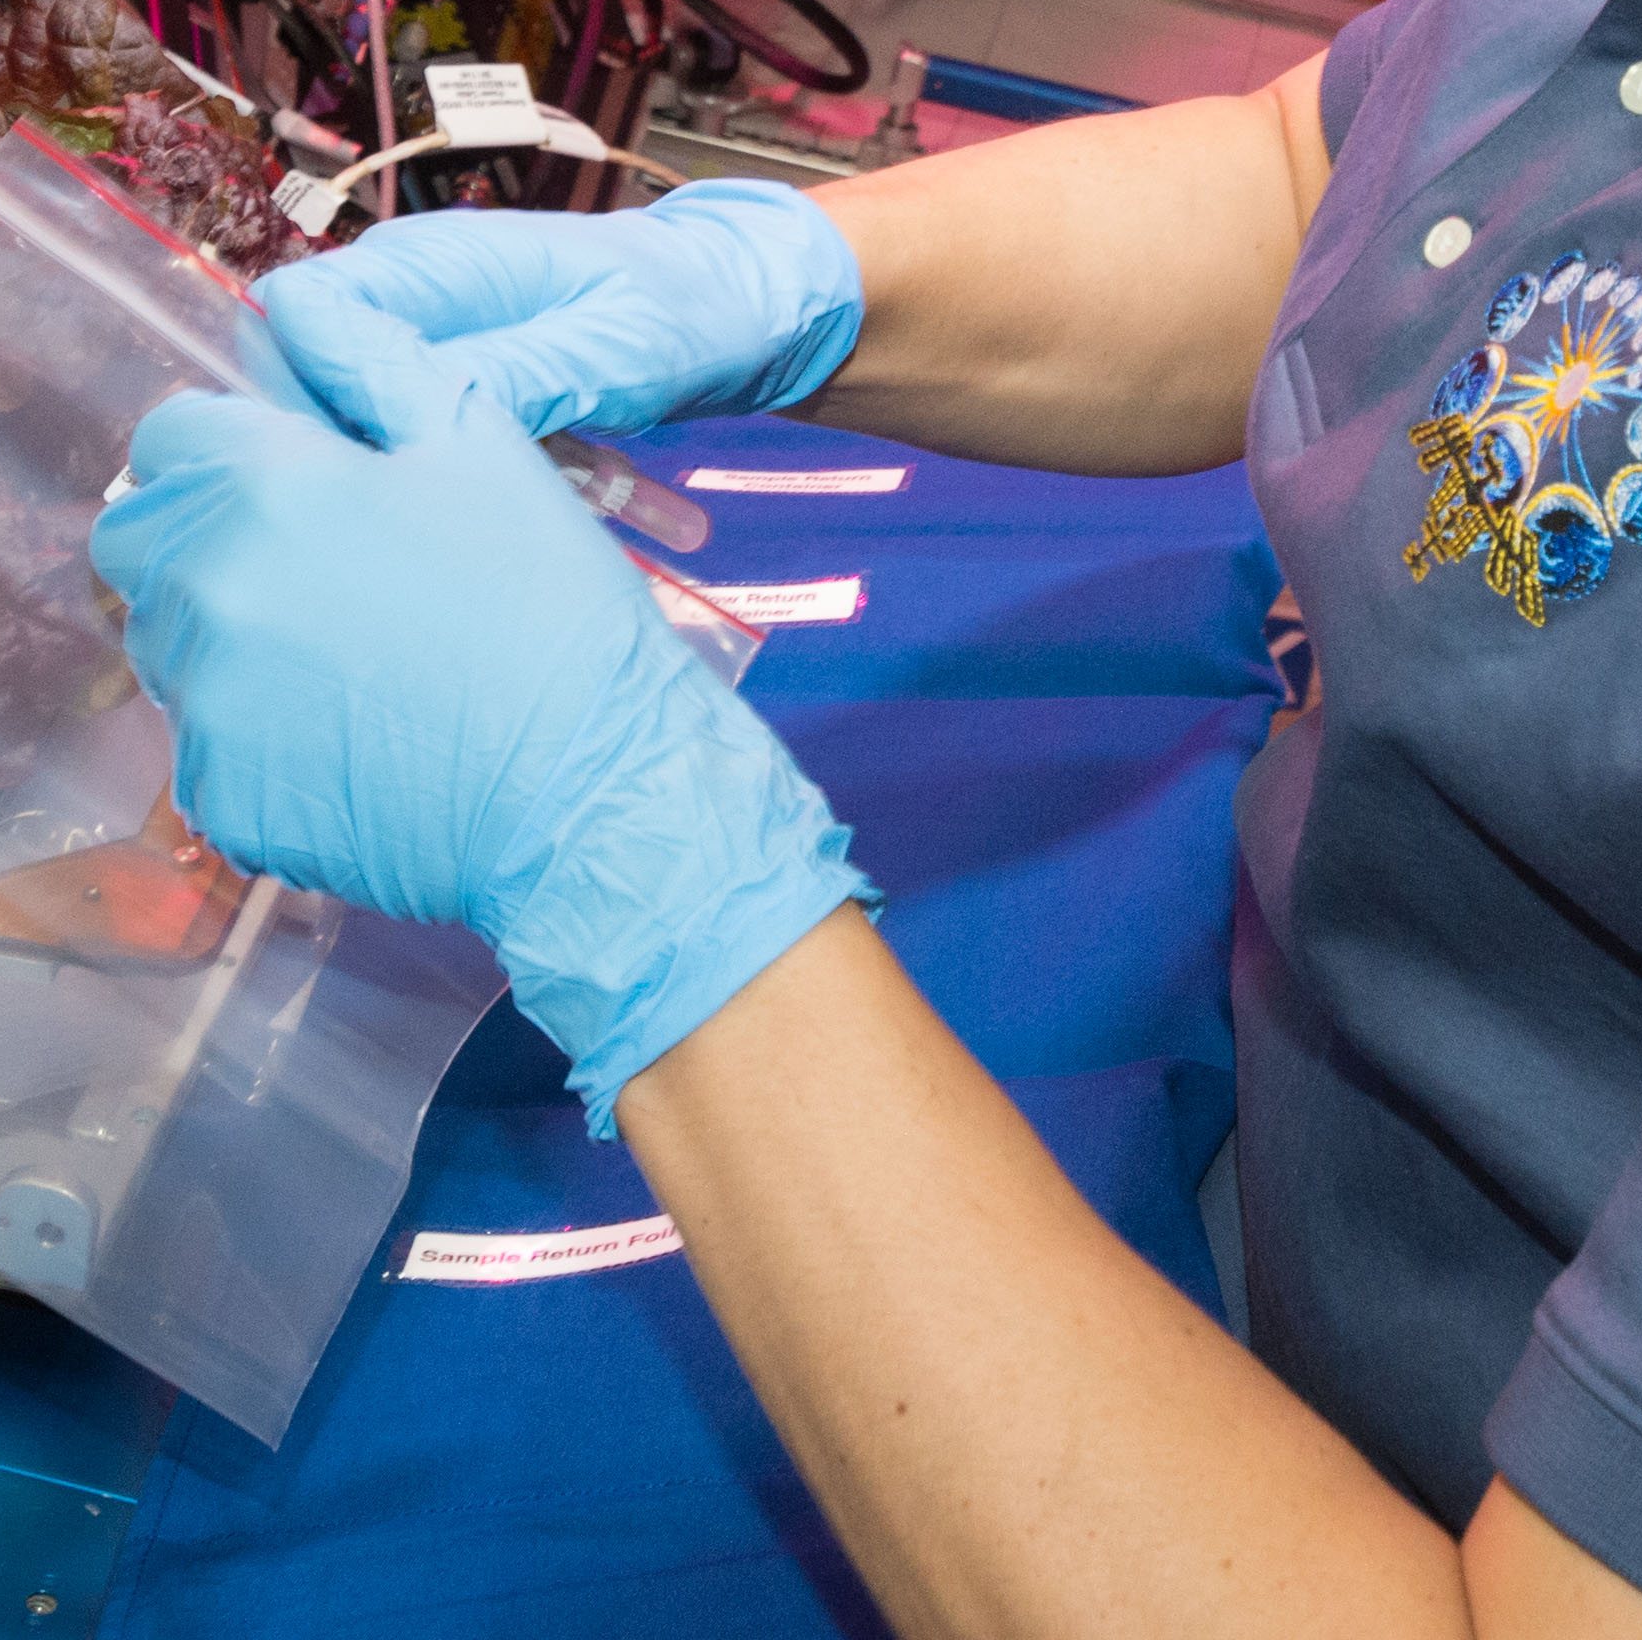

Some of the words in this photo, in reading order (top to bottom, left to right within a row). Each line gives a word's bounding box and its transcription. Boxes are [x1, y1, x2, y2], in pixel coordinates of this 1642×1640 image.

[724, 473, 798, 483] Sample
[805, 474, 872, 482] Return
[746, 593, 817, 602] Return
[421, 1250, 521, 1269] Sample
[529, 1242, 619, 1262] Return
